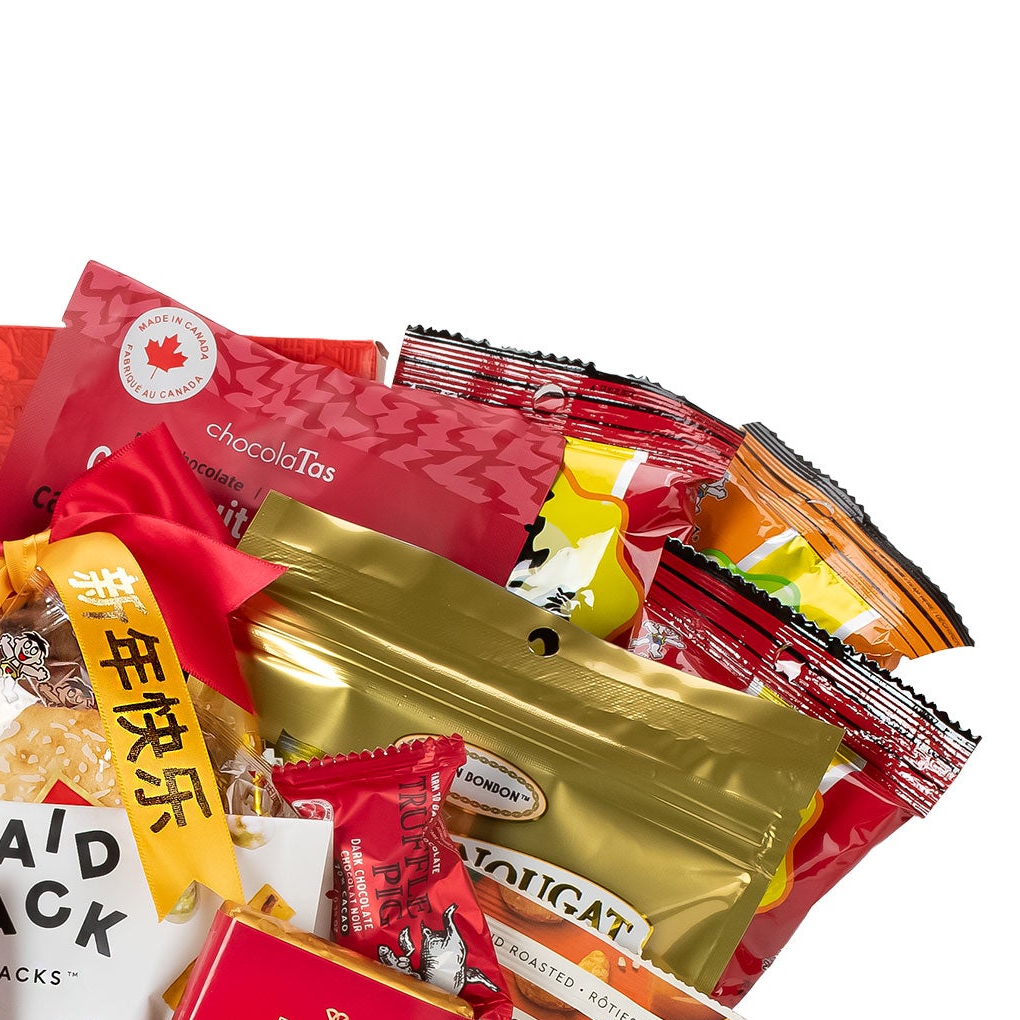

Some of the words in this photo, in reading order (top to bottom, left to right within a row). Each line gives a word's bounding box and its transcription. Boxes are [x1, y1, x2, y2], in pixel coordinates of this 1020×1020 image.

[138, 314, 169, 332] MADE
[171, 315, 183, 325] IN
[184, 321, 209, 361] CANADA
[123, 343, 143, 393] FABRIQUÉ
[142, 389, 156, 399] AU
[159, 375, 204, 399] CANADA
[182, 449, 245, 491] ocolate
[206, 422, 337, 483] chocolaTas
[433, 794, 442, 804] TO
[350, 837, 362, 866] DARK
[398, 775, 433, 920] TRUFFLE
[340, 850, 357, 906] CHOCOLAT
[350, 905, 362, 933] NOIR
[341, 889, 349, 932] CACAO
[354, 866, 374, 931] CHOCOLATE
[371, 861, 405, 927] PIG
[509, 944, 575, 989] ROASTED
